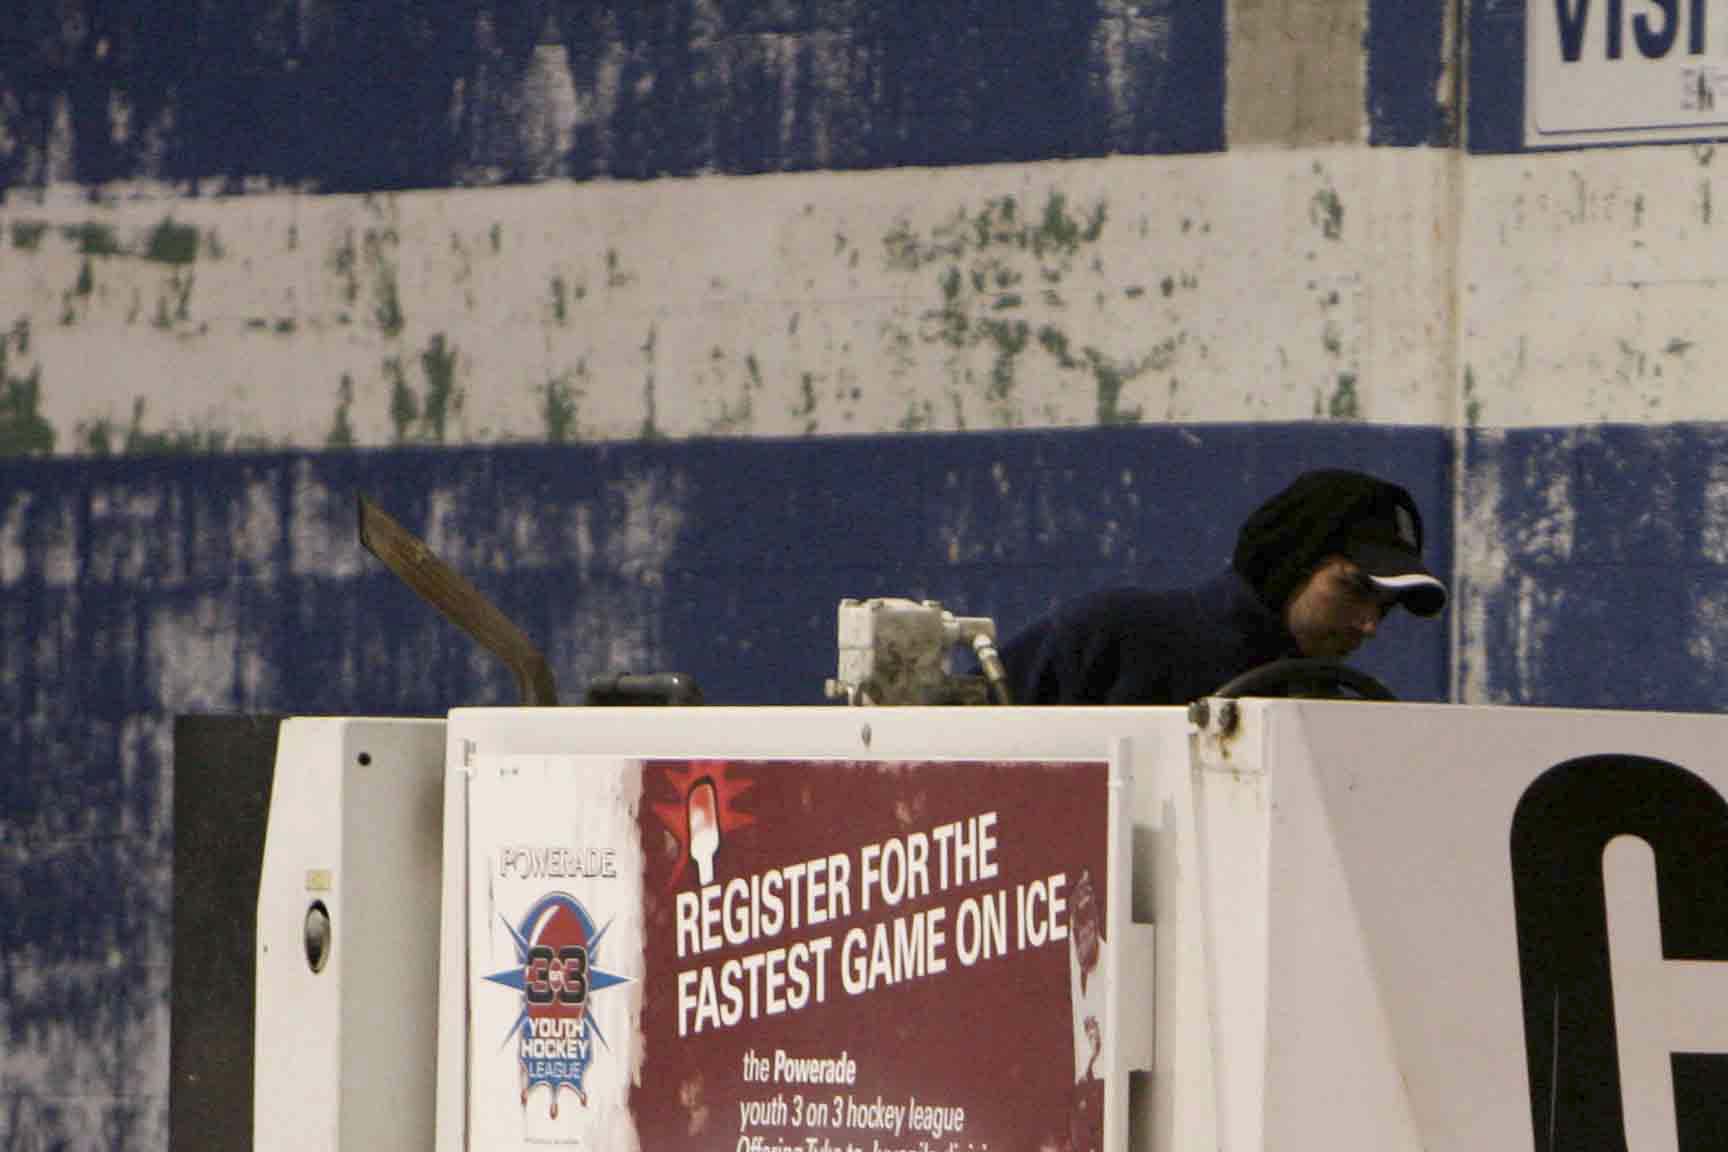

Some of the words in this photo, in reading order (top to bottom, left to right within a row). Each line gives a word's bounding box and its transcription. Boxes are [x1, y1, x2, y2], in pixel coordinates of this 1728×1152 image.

[499, 848, 617, 880] POWERADE
[676, 852, 851, 958] REGISTER
[861, 832, 930, 911] FOR
[933, 811, 999, 890] THE
[677, 936, 833, 1038] FASTEST
[841, 906, 947, 995] GAME
[956, 890, 1007, 966] ON
[1016, 873, 1068, 950] ICE
[529, 1018, 585, 1038] YOUTH
[521, 1038, 588, 1058] HOCKEY
[529, 1061, 581, 1079] LEAGUE
[743, 1049, 770, 1082] the
[773, 1049, 857, 1085] Powerade
[740, 1093, 788, 1132] youth
[791, 1094, 804, 1127] 3
[806, 1101, 828, 1128] on
[831, 1095, 844, 1128] 3
[846, 1095, 906, 1137] hockey
[908, 1097, 965, 1139] league
